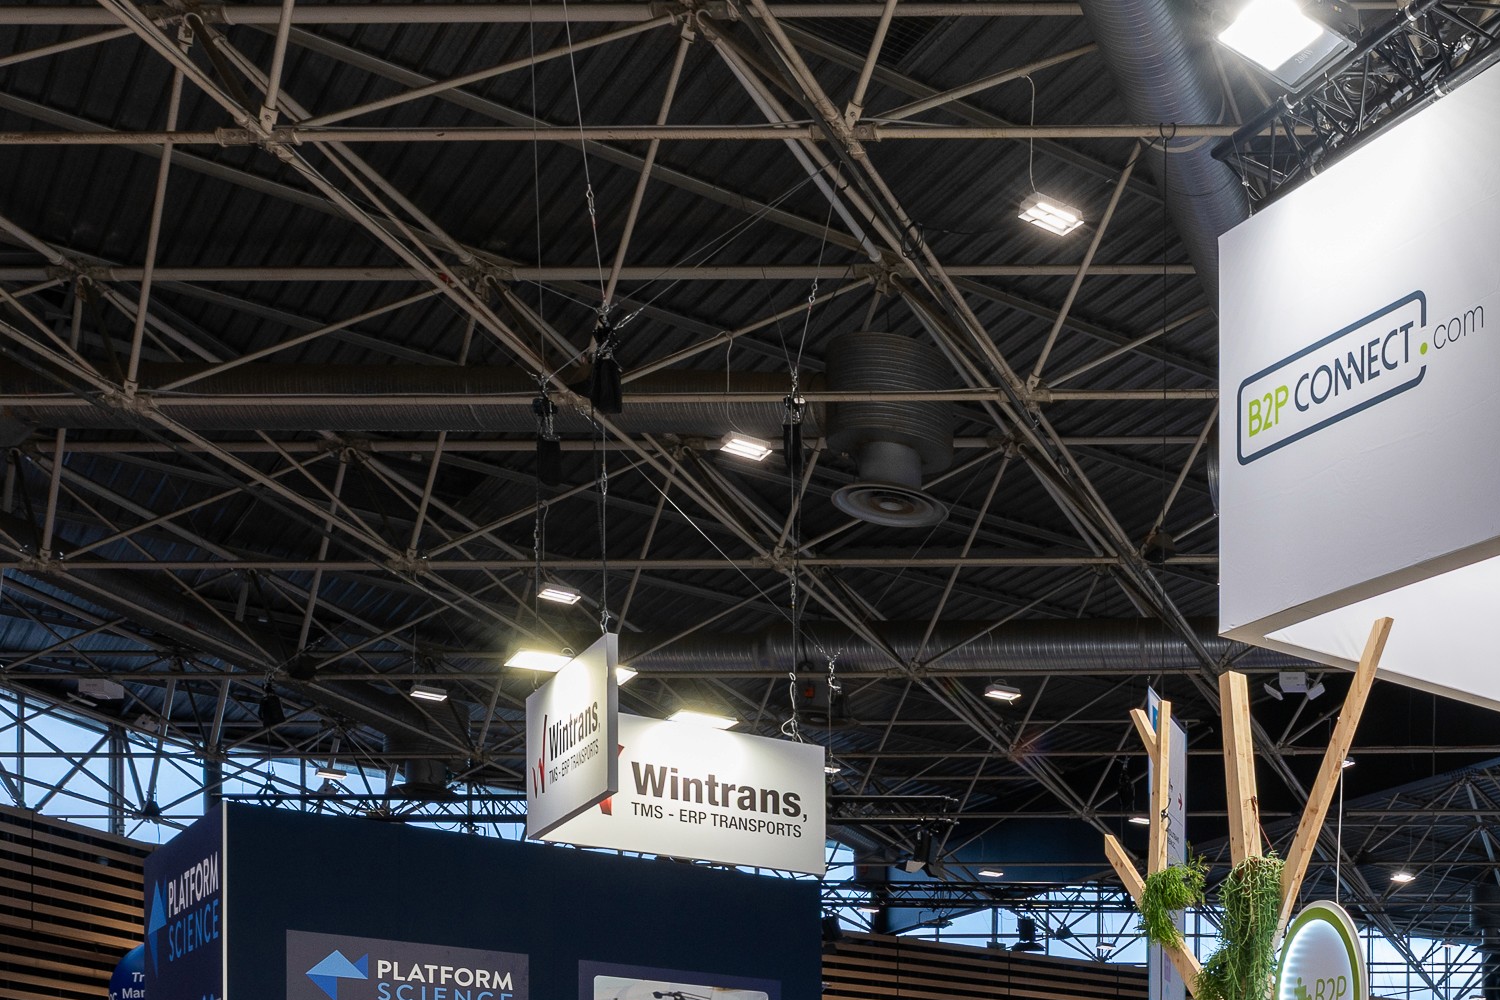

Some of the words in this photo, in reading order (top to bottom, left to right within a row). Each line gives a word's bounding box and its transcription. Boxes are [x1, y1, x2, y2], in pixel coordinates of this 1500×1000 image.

[1248, 384, 1289, 438] B2P
[549, 767, 558, 784] TMS
[570, 738, 599, 771] TRANSPORTS
[631, 801, 663, 819] TMS
[680, 809, 707, 825] ERP
[711, 813, 802, 838] TRANSPORTS
[168, 851, 219, 918] PLATFORM
[168, 898, 219, 962] SCIENCE
[377, 959, 514, 991] PLATFORM
